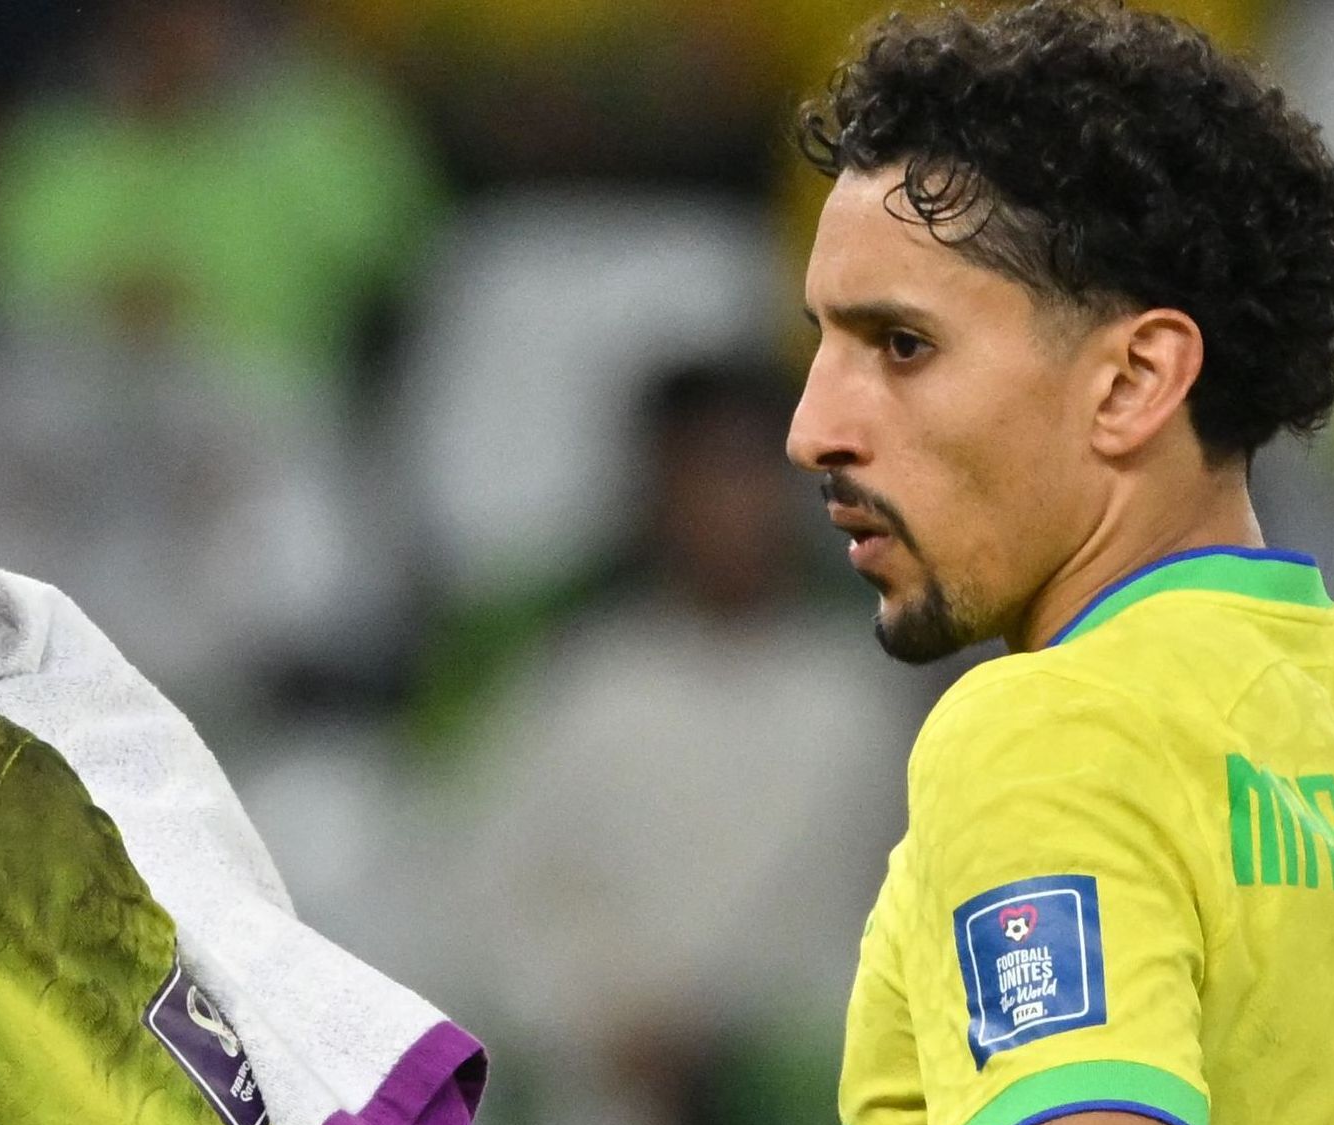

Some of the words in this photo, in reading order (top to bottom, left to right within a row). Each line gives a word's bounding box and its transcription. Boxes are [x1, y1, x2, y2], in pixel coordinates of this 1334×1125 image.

[996, 945, 1052, 973] FOOTBALL
[998, 961, 1053, 994] UNITES
[999, 992, 1016, 1014] the
[1016, 978, 1058, 1004] World
[1015, 1006, 1039, 1020] FIFA
